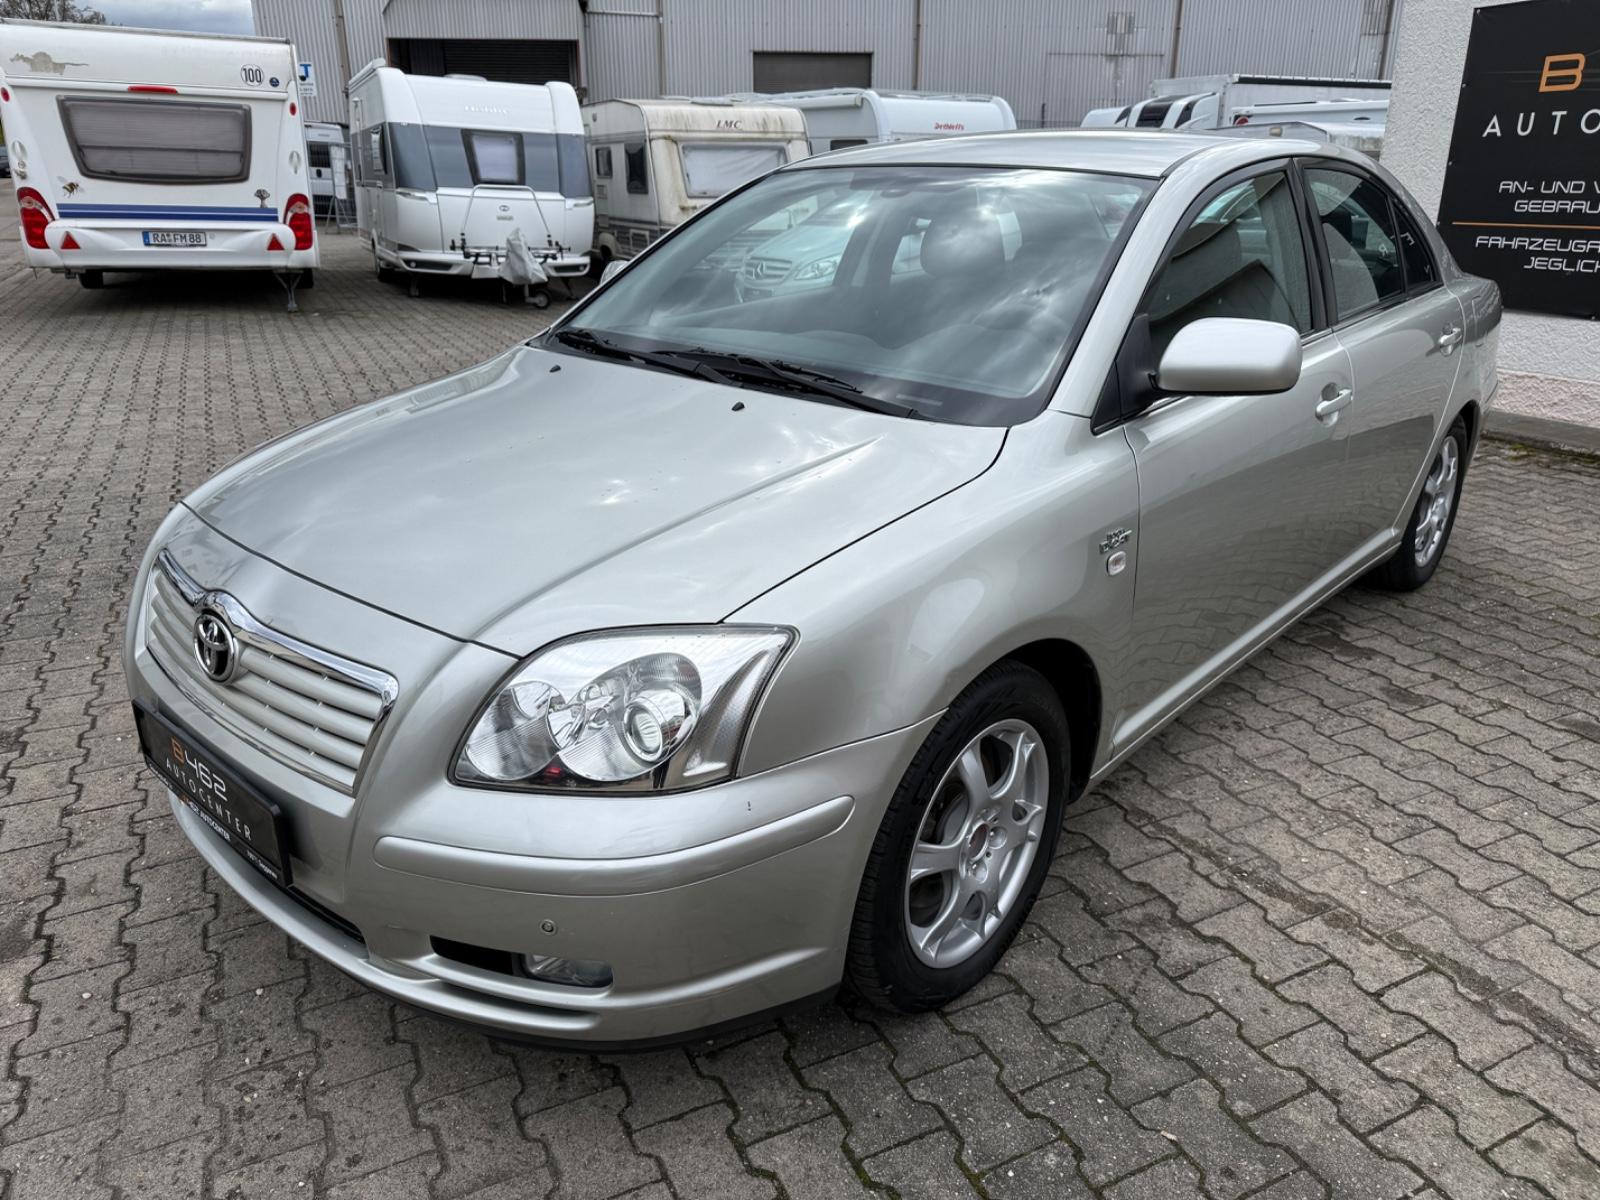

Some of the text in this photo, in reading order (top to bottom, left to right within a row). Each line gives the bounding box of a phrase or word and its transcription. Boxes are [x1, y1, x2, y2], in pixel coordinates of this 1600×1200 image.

[242, 67, 262, 83] 100
[1539, 53, 1586, 92] B
[716, 119, 743, 130] LMC
[1482, 108, 1600, 138] AUTO
[1498, 181, 1534, 193] AN-
[1540, 181, 1586, 194] UND
[1514, 200, 1600, 214] GEBRAU
[1475, 236, 1600, 253] FAHRZEUGA
[171, 737, 228, 802] B462
[166, 757, 252, 841] AUTOCENTER
